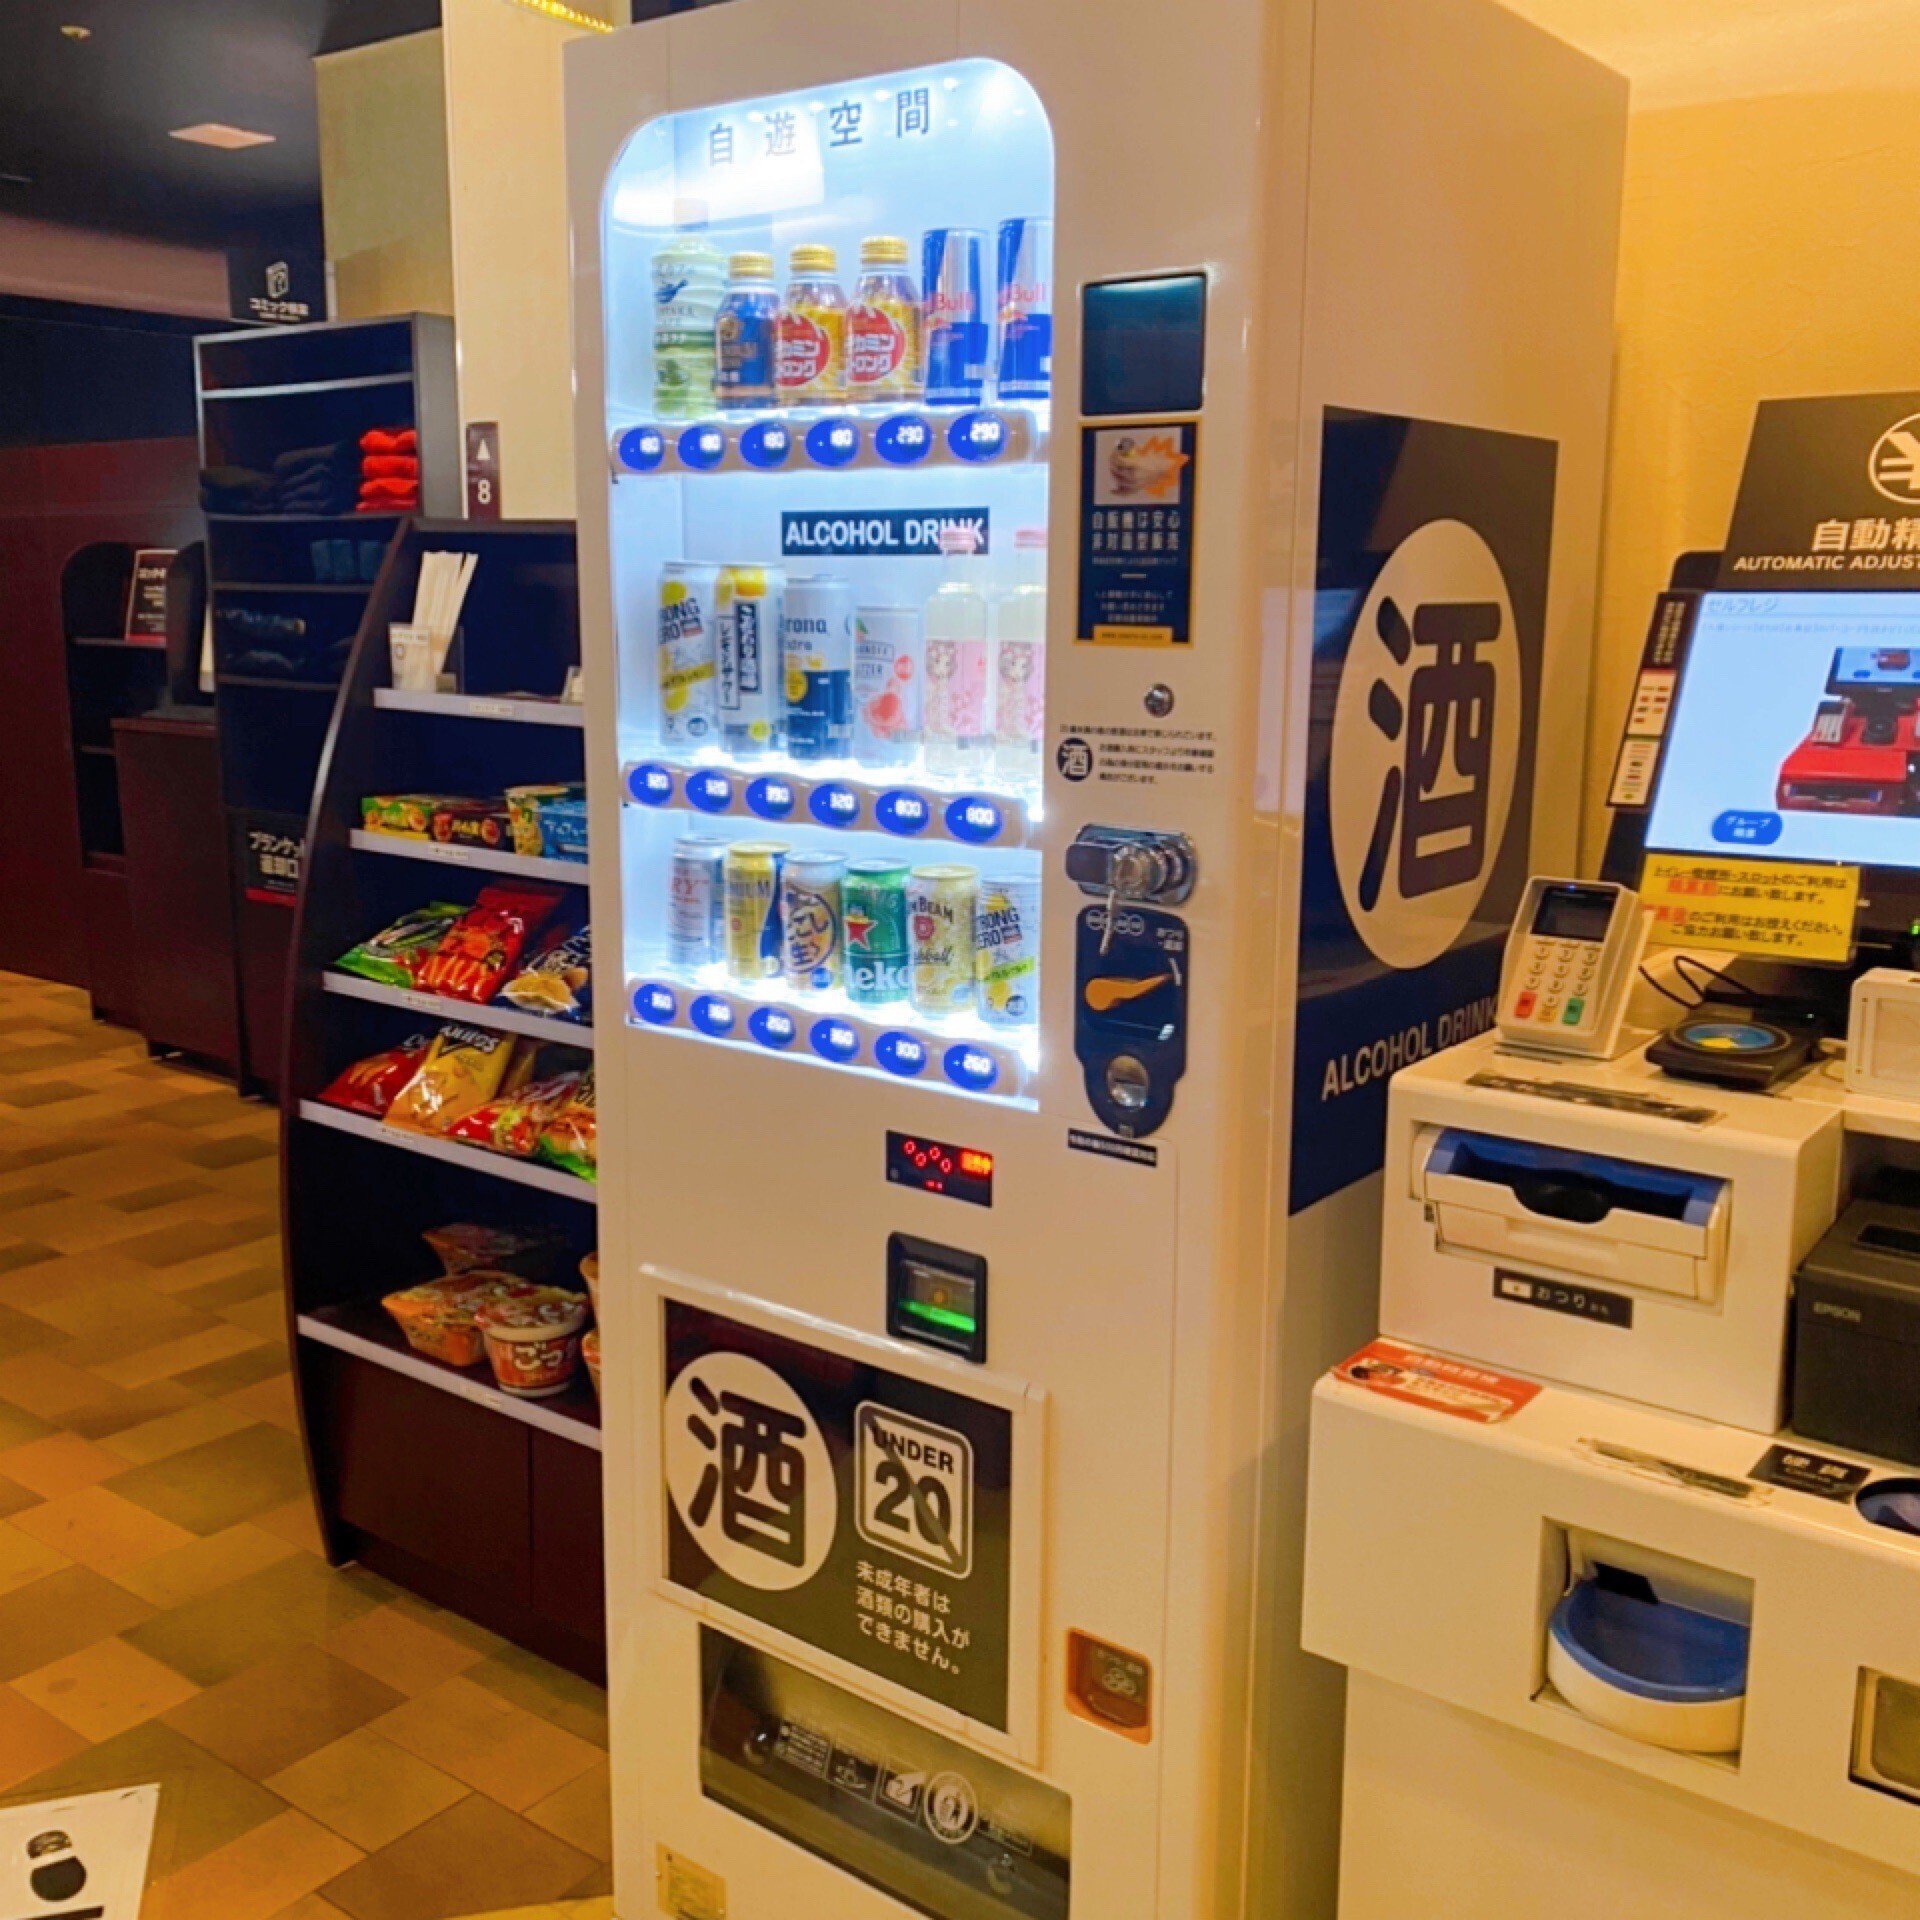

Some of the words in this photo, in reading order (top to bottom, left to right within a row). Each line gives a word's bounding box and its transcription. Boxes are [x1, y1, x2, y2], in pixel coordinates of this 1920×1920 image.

[709, 87, 928, 167] 自遊空間
[477, 478, 491, 505] 8
[785, 519, 899, 547] ALCOHOL
[1733, 556, 1845, 571] AUTOMATIC
[1359, 595, 1502, 912] 酒
[1321, 1020, 1433, 1103] ALCOHOL
[686, 1376, 807, 1569] 酒
[873, 1424, 954, 1475] UNDER
[874, 1460, 951, 1547] 20
[856, 1560, 951, 1615] 未成年者は
[856, 1585, 971, 1649] 酒類の購入が
[857, 1613, 960, 1675] できません。
